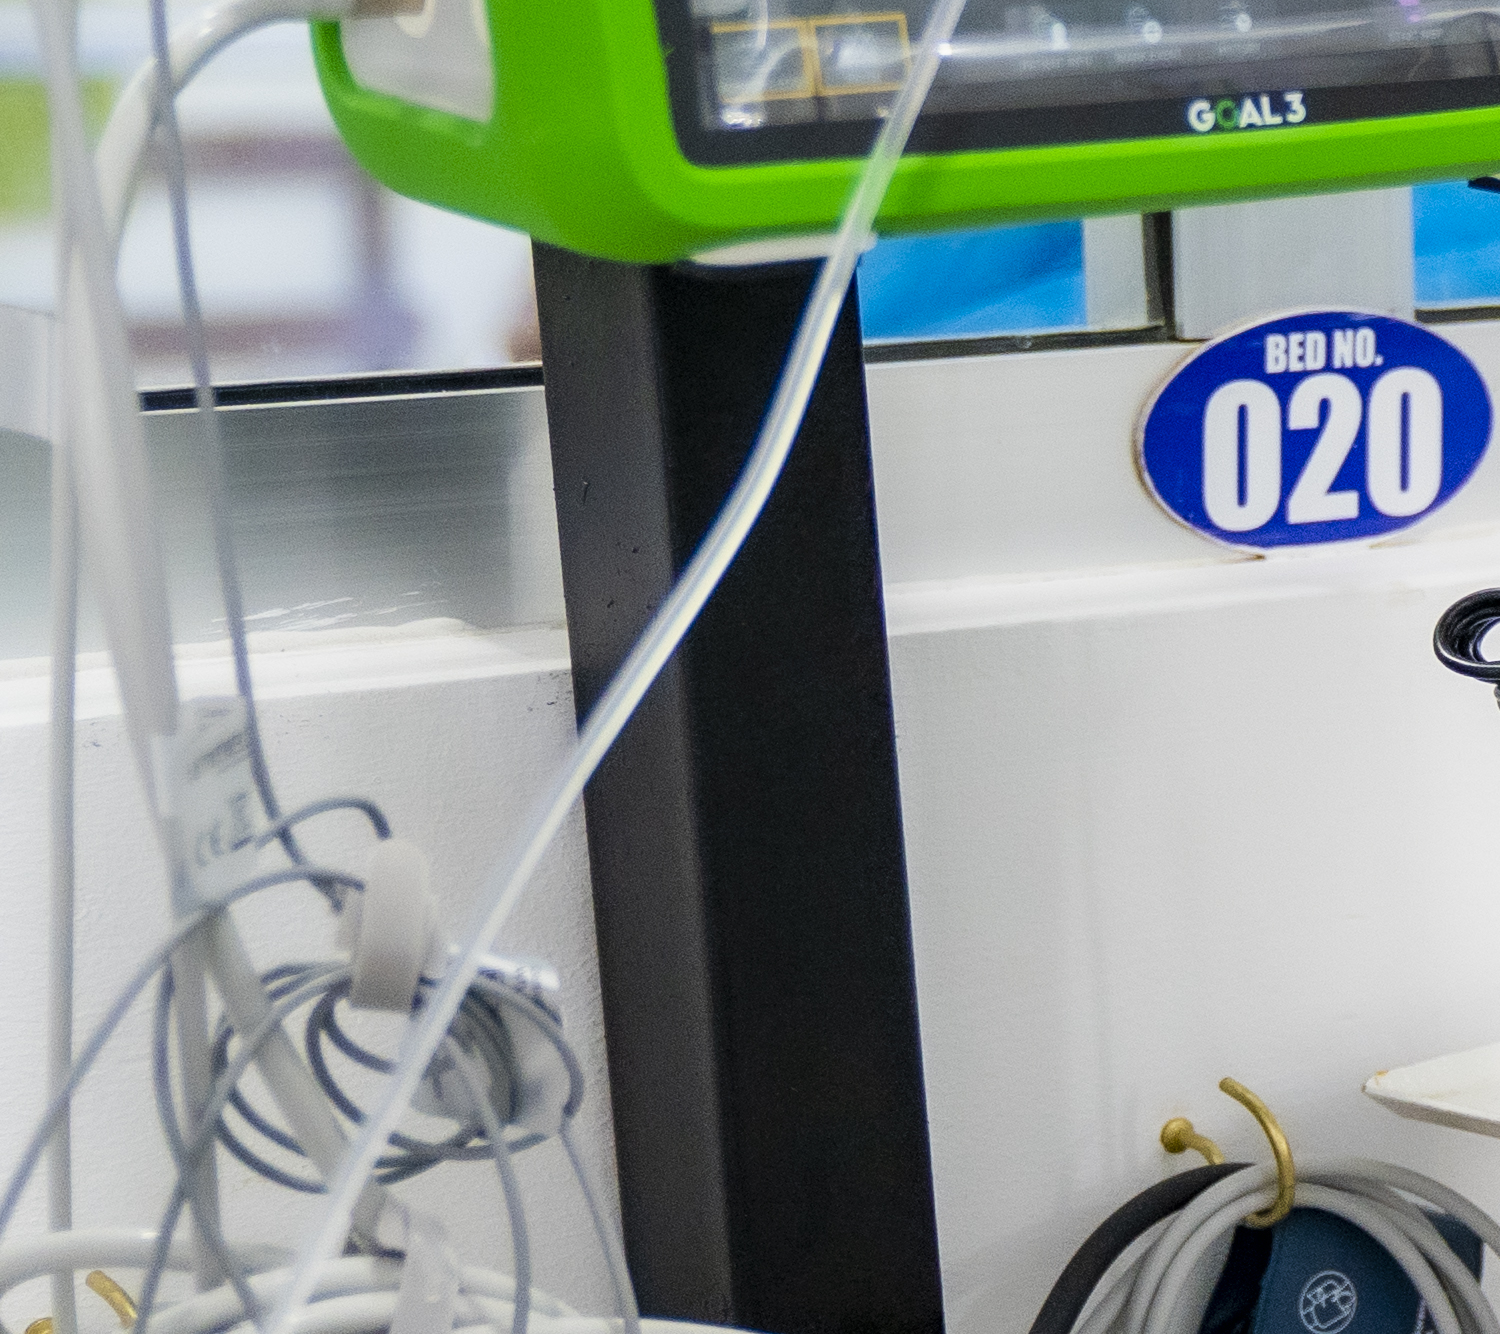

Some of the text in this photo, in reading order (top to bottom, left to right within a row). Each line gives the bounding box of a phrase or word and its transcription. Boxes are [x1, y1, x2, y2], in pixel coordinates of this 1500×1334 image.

[1265, 327, 1384, 374] BED NO.
[1203, 366, 1443, 532] 020
